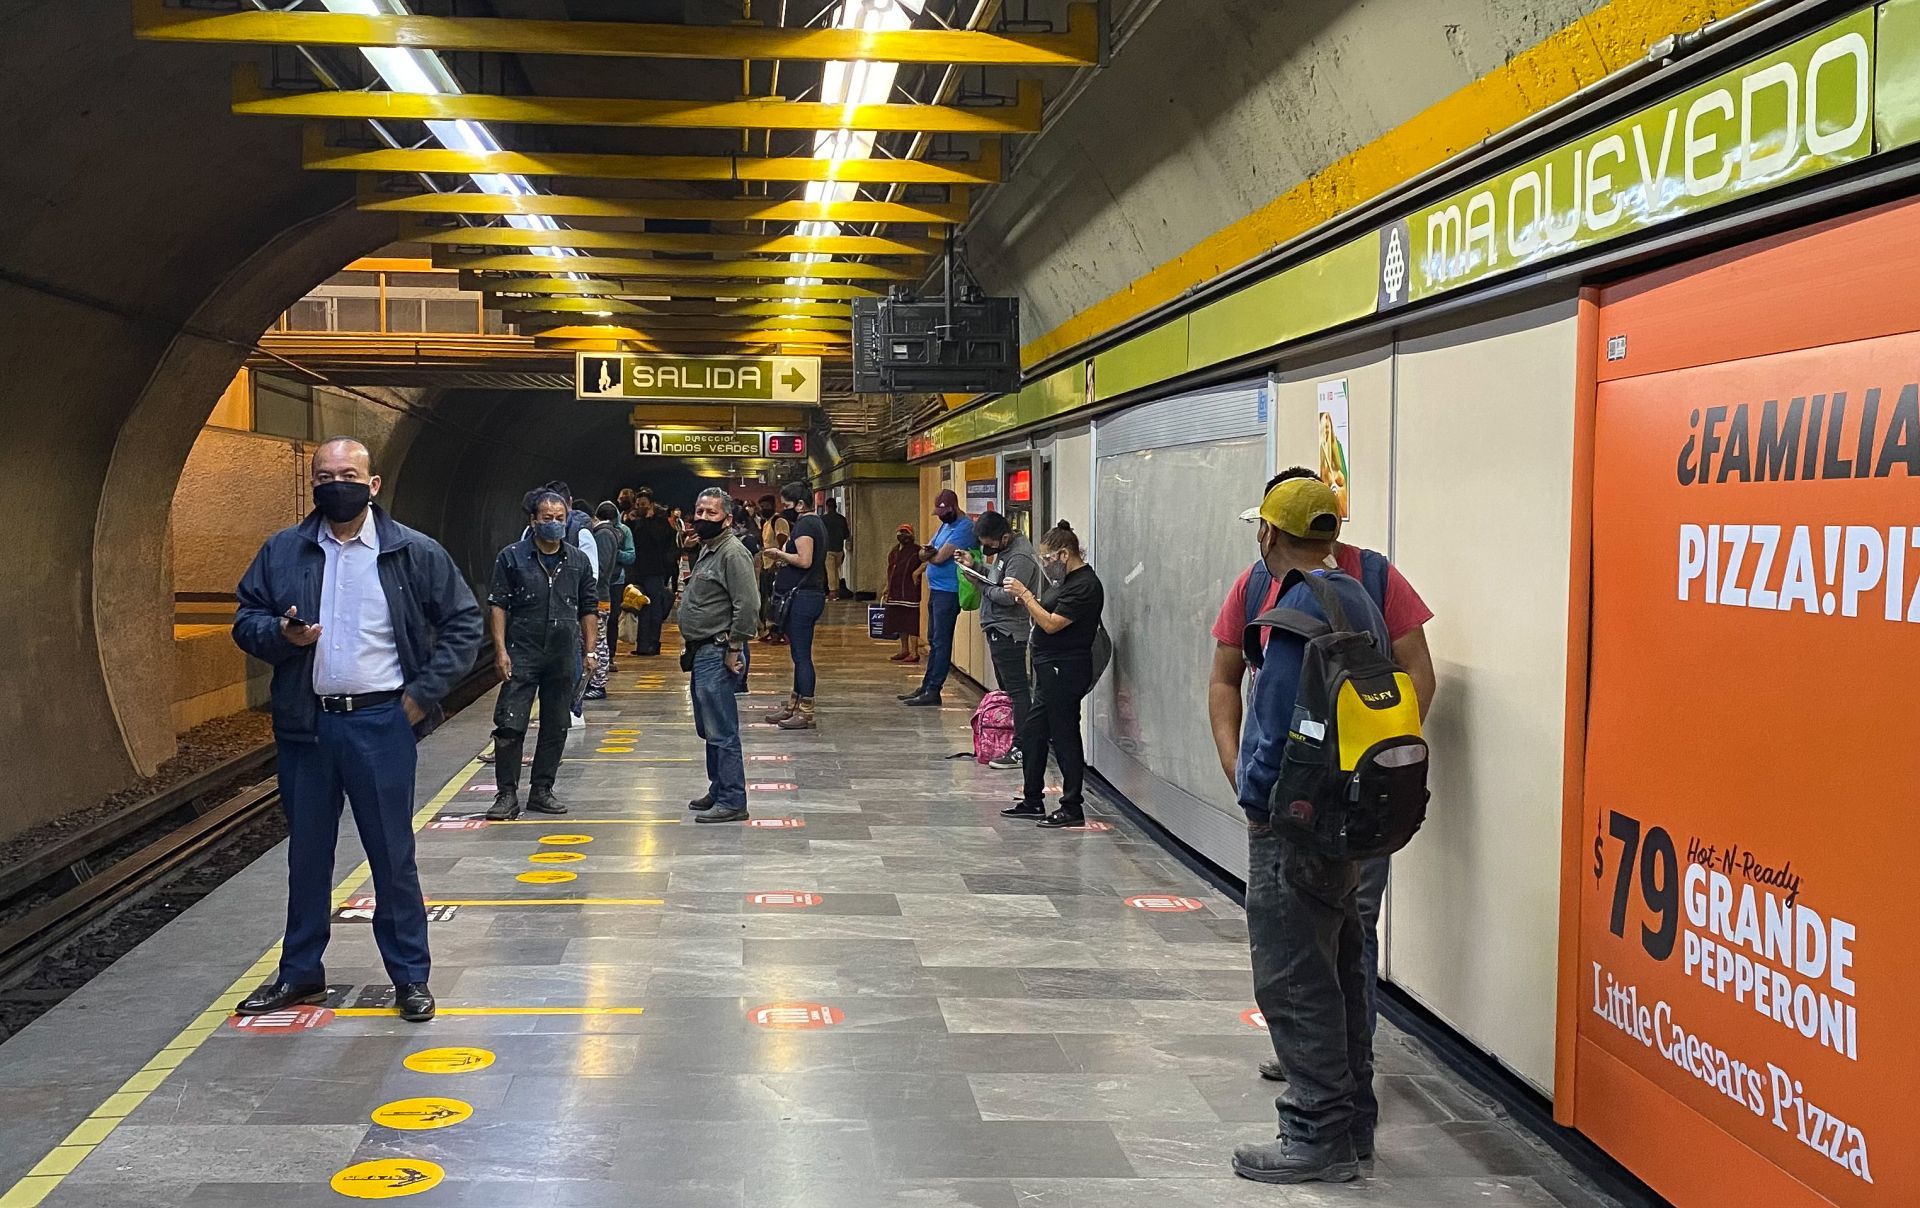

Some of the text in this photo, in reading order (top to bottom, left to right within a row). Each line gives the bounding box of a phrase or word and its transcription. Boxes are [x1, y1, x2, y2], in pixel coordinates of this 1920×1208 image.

[1507, 32, 1869, 256] QUEVEDO
[632, 366, 761, 390] SALIDA
[662, 443, 758, 453] INDIOS VERDES
[1684, 863, 1857, 997] GRANDE
[1684, 929, 1858, 1062] PEPPERONI
[1592, 961, 1653, 1048] Little
[1766, 1062, 1874, 1184] Pizza
